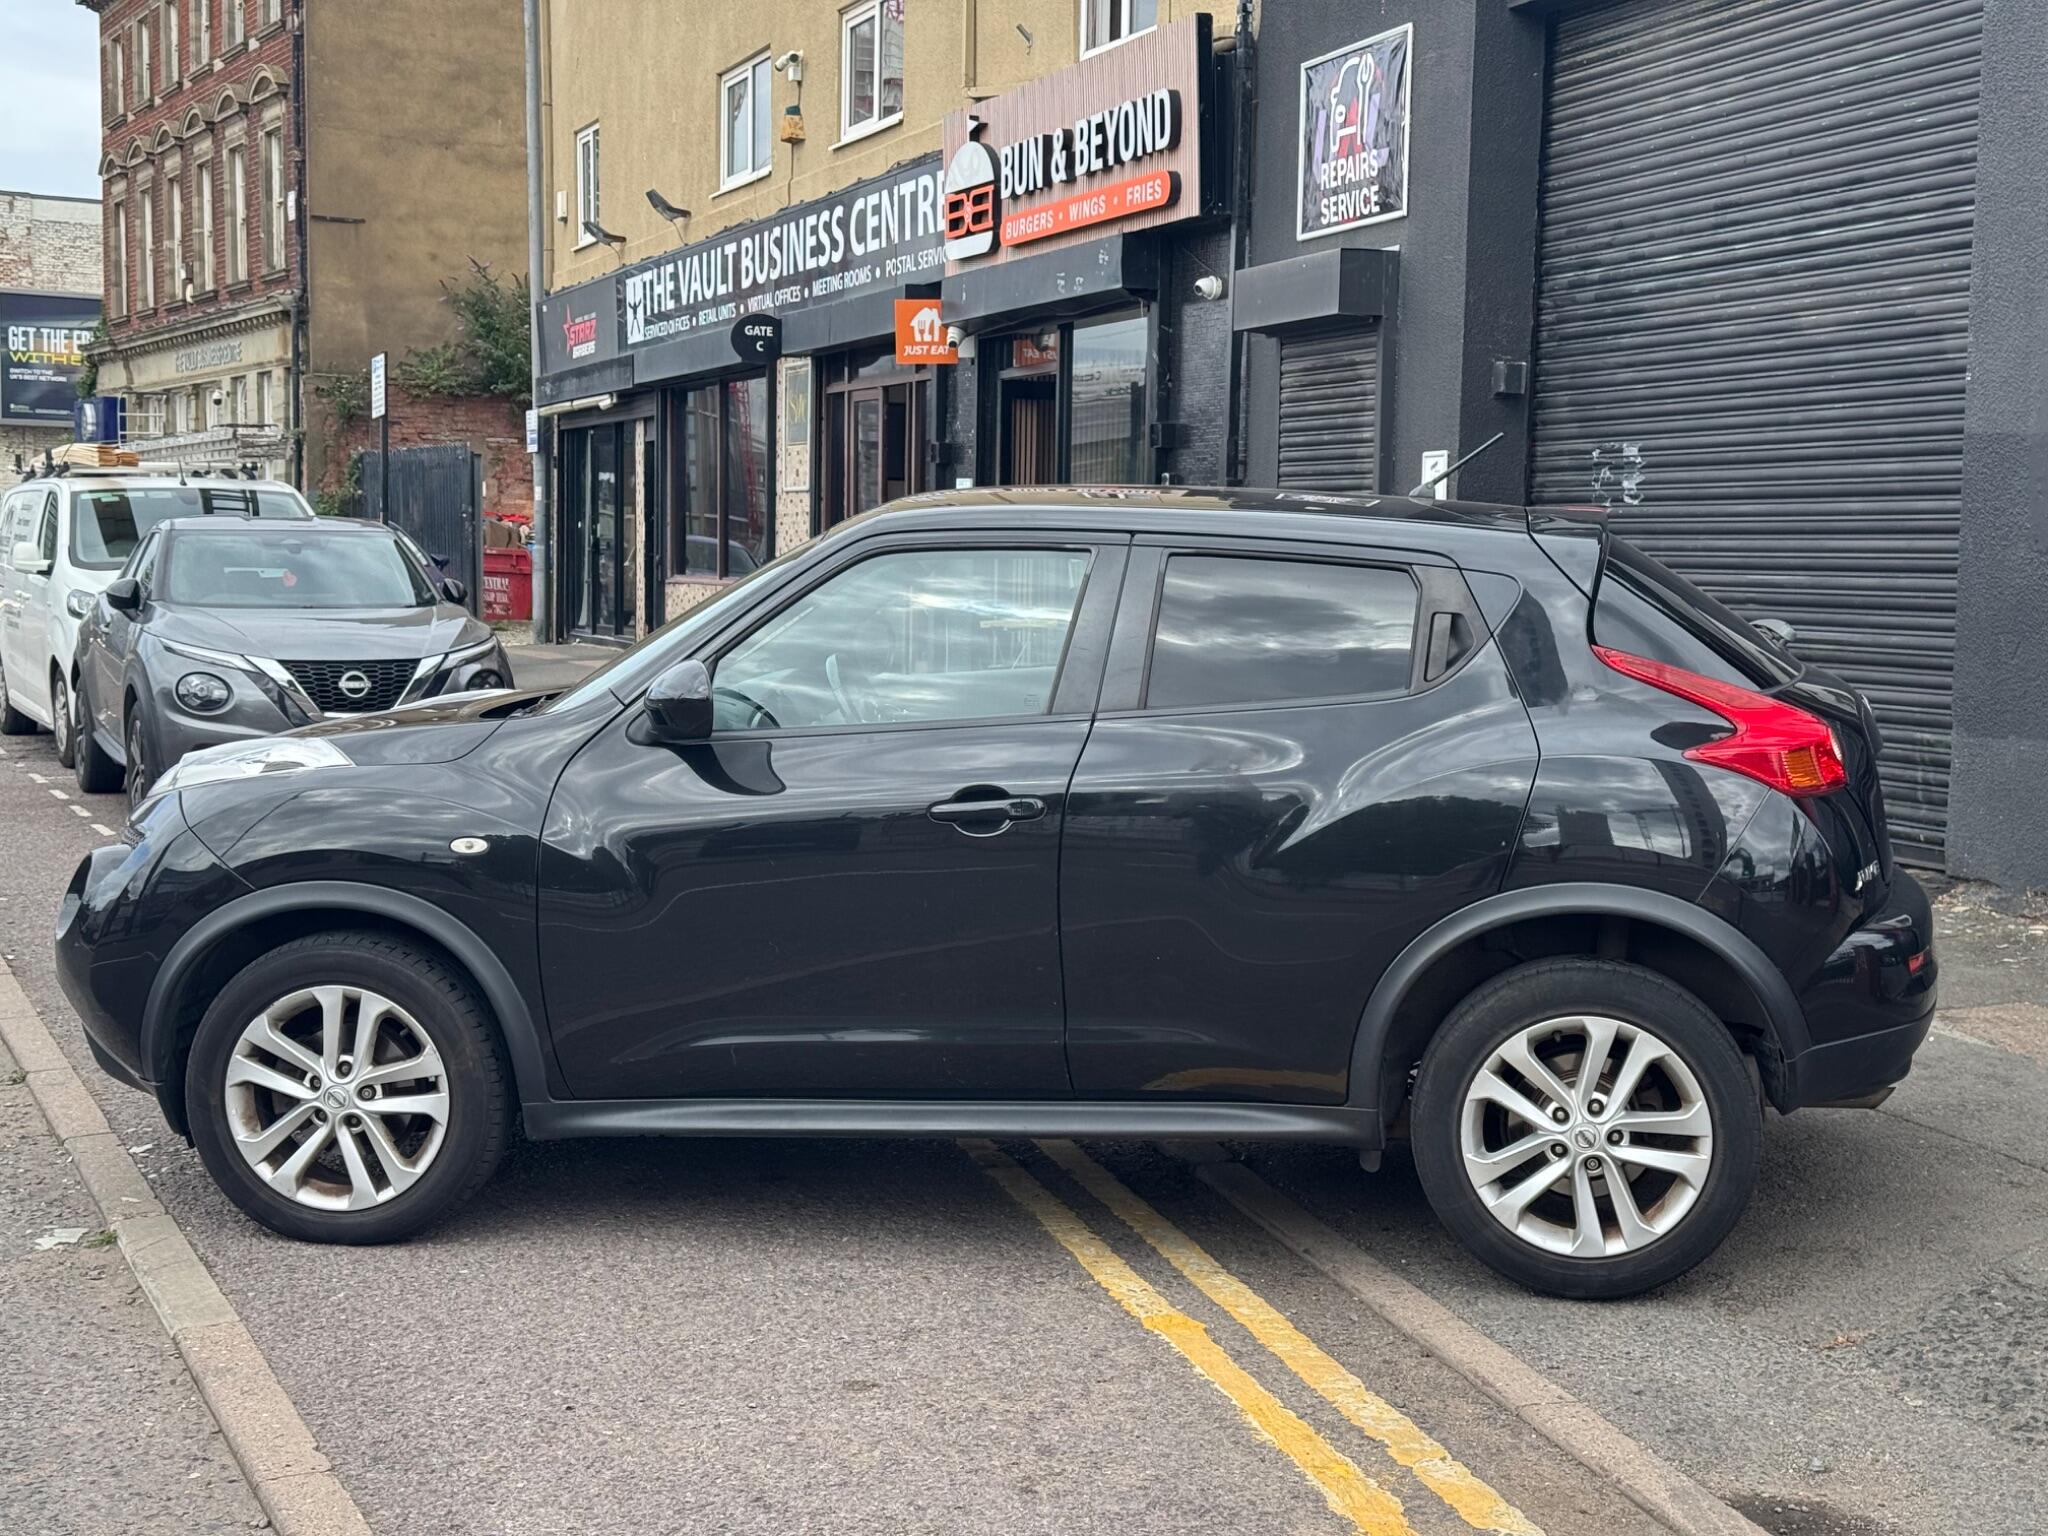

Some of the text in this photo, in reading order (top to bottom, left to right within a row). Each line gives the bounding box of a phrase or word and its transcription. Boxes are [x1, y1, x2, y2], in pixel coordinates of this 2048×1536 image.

[1001, 88, 1171, 199] BUN & BEYOND
[1320, 149, 1378, 190] REPAIRS
[1005, 178, 1162, 240] BURGERS WINGS FRIES
[1320, 185, 1380, 225] SERVICE
[642, 170, 946, 316] THE VAULT BUSINESS CENTRE
[699, 308, 718, 326] RETAIL
[718, 302, 737, 321] UNITS
[747, 292, 774, 313] VIRTUAL
[774, 284, 801, 306] OFFICES
[812, 272, 843, 297] MEETING
[844, 264, 872, 289] ROOMS
[885, 255, 917, 278] POSTAL
[918, 246, 947, 270] SERVIC
[8, 326, 36, 352] GET
[40, 328, 69, 354] THE
[569, 320, 596, 346] STARZ
[744, 325, 774, 337] GATE
[756, 341, 764, 352] C
[10, 351, 67, 365] WITH
[904, 345, 950, 356] JUST EAT
